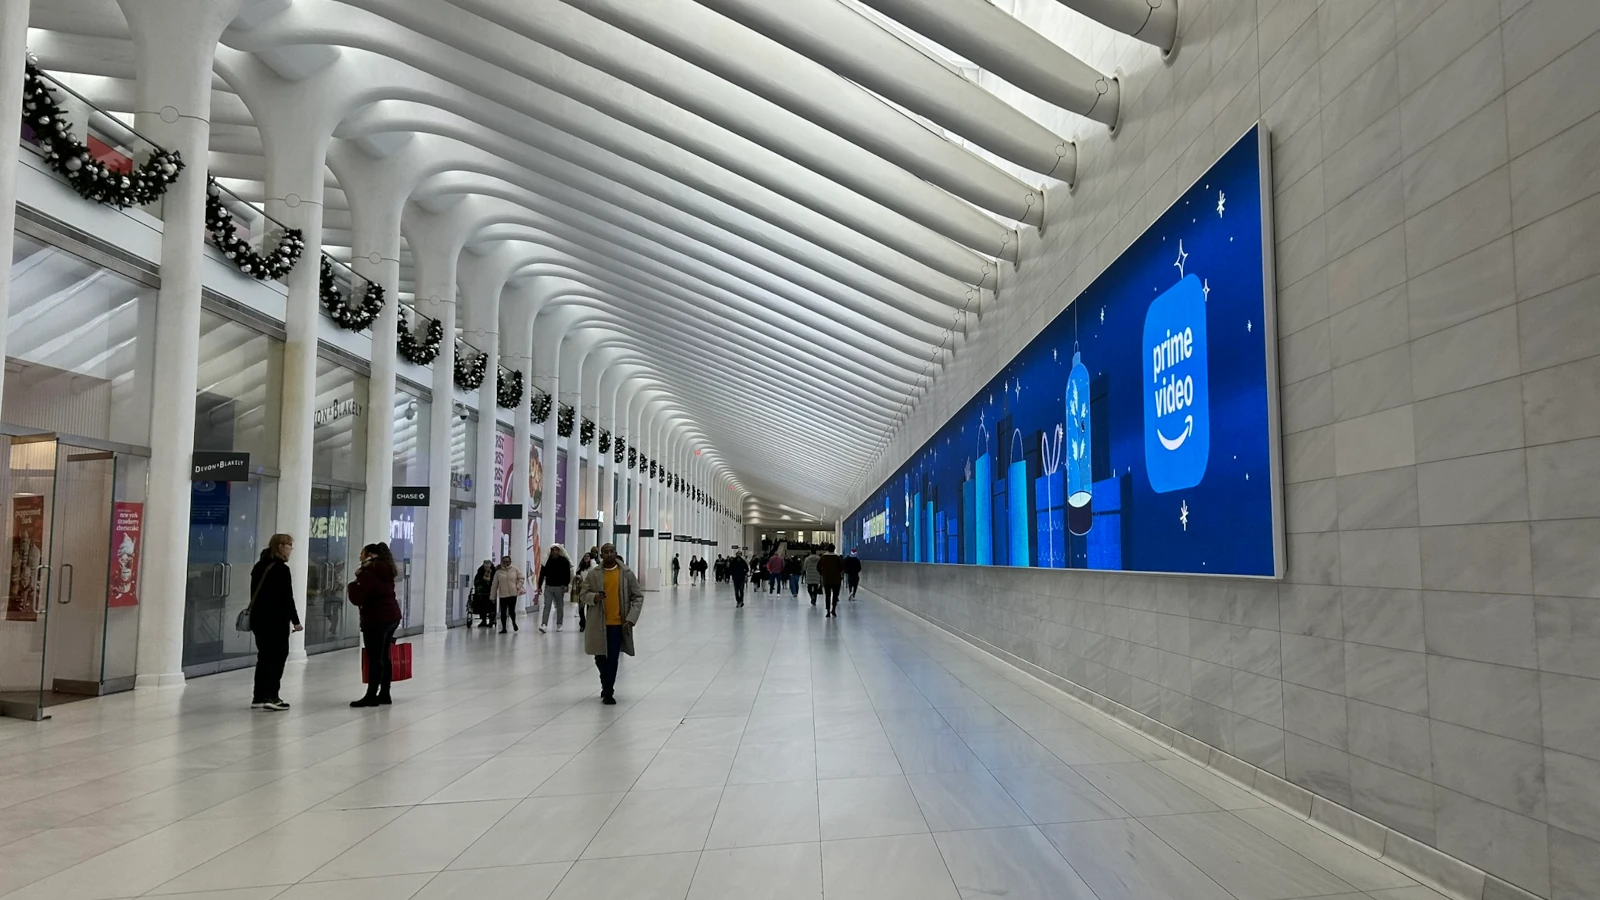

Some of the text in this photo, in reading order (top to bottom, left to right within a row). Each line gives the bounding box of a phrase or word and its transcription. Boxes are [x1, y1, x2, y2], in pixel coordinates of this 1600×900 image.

[1152, 326, 1193, 384] prime
[1154, 373, 1194, 418] video
[333, 398, 363, 421] BLAKELY
[195, 463, 217, 473] DEVON
[219, 459, 244, 469] BLAKELY
[129, 510, 138, 519] york
[116, 524, 139, 532] cheesecake
[117, 518, 139, 526] strawberry
